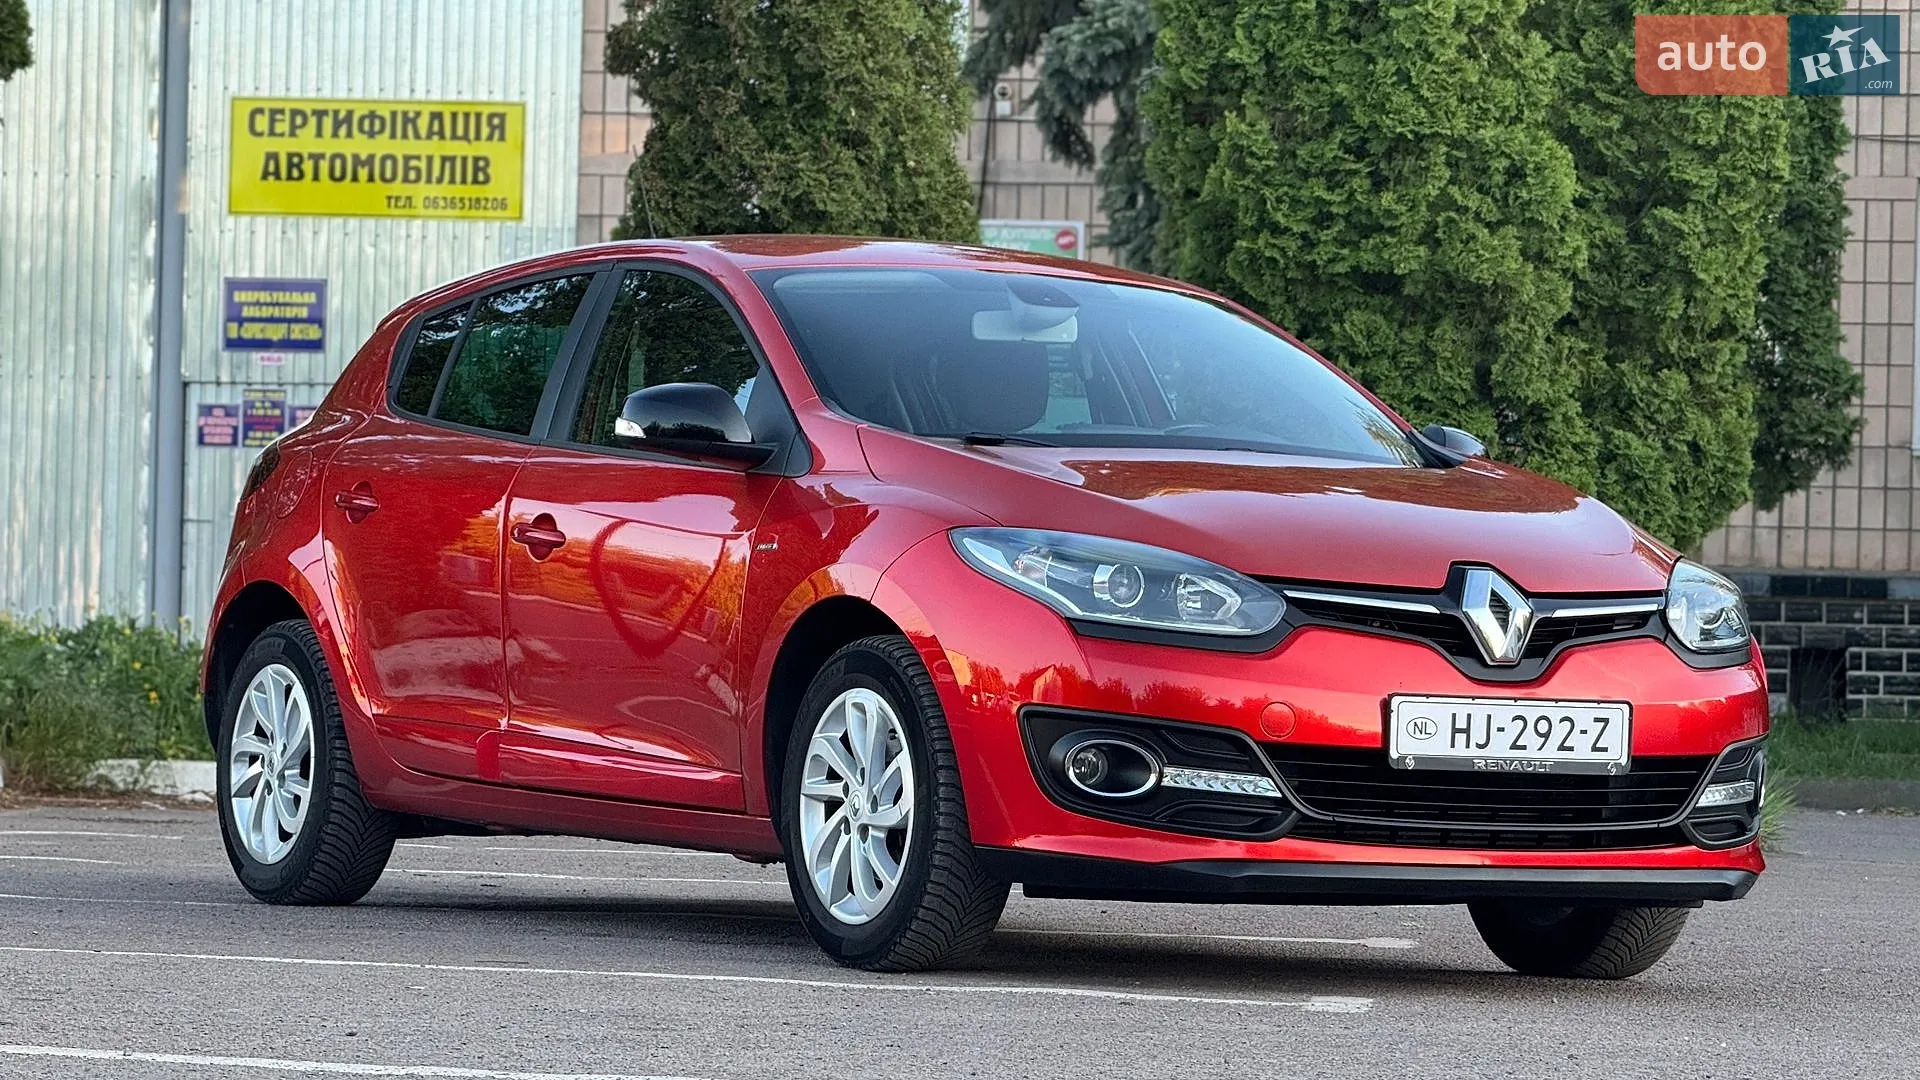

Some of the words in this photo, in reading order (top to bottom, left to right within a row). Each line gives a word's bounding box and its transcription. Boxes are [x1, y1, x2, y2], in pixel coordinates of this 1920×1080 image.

[248, 107, 507, 143] СЕРТИФІКАЦІЯ
[260, 152, 491, 185] АВТОМОБІЛІВ
[386, 195, 417, 209] ТЕЛ.
[423, 197, 508, 211] 0636518206
[1413, 721, 1432, 735] NL
[1450, 713, 1610, 752] HJ-292-Z
[1473, 760, 1554, 772] RENAULT
